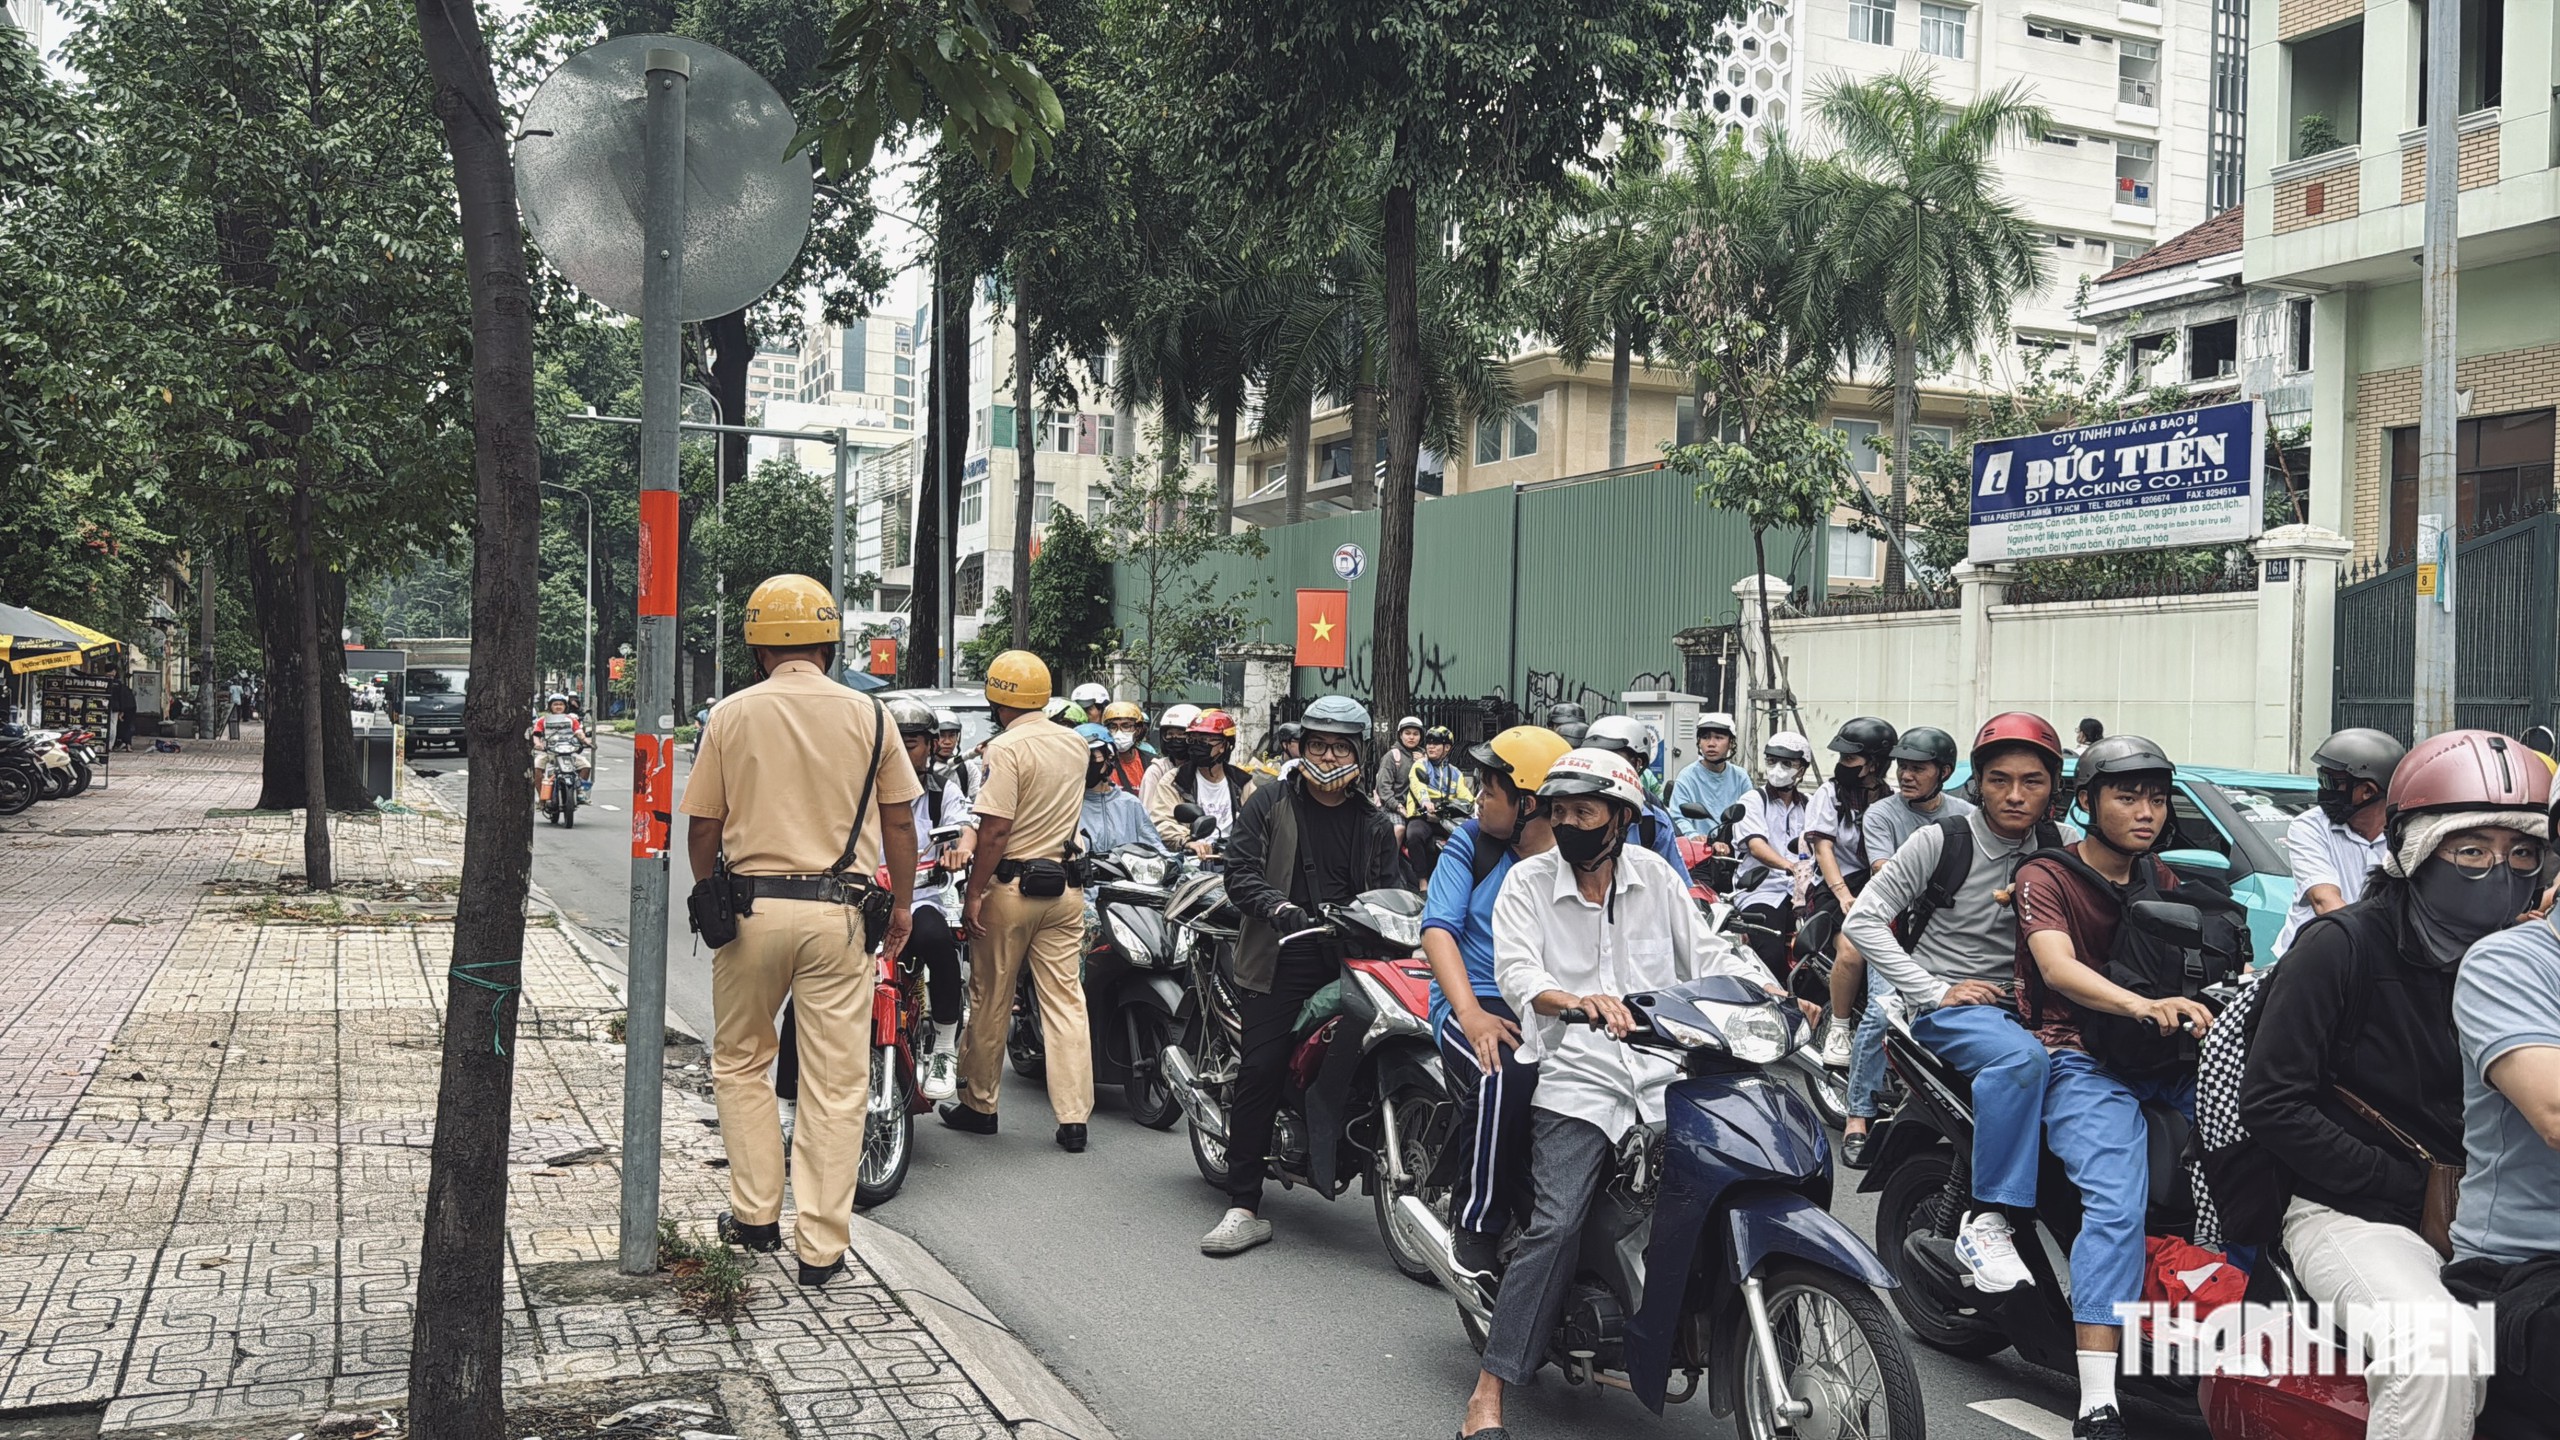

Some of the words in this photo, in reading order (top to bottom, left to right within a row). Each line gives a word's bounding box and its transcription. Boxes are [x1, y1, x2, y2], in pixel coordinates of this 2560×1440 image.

[2052, 432, 2076, 446] CTY
[2079, 426, 2111, 442] TNHH
[2114, 425, 2126, 436] IN
[2129, 421, 2147, 435] ẤN
[2149, 420, 2157, 431] &
[2160, 416, 2184, 429] BAO
[2187, 412, 2198, 425] BÌ
[2025, 444, 2105, 490] ĐỨC
[2114, 426, 2229, 478] TIẾN
[2025, 487, 2049, 505] ĐT
[2055, 479, 2142, 500] PACKING
[2088, 501, 2104, 510] TEL:
[2186, 490, 2205, 500] FAX:
[2205, 487, 2237, 498] 8294514
[2267, 560, 2288, 575] 161A
[988, 676, 1018, 693] CSGT
